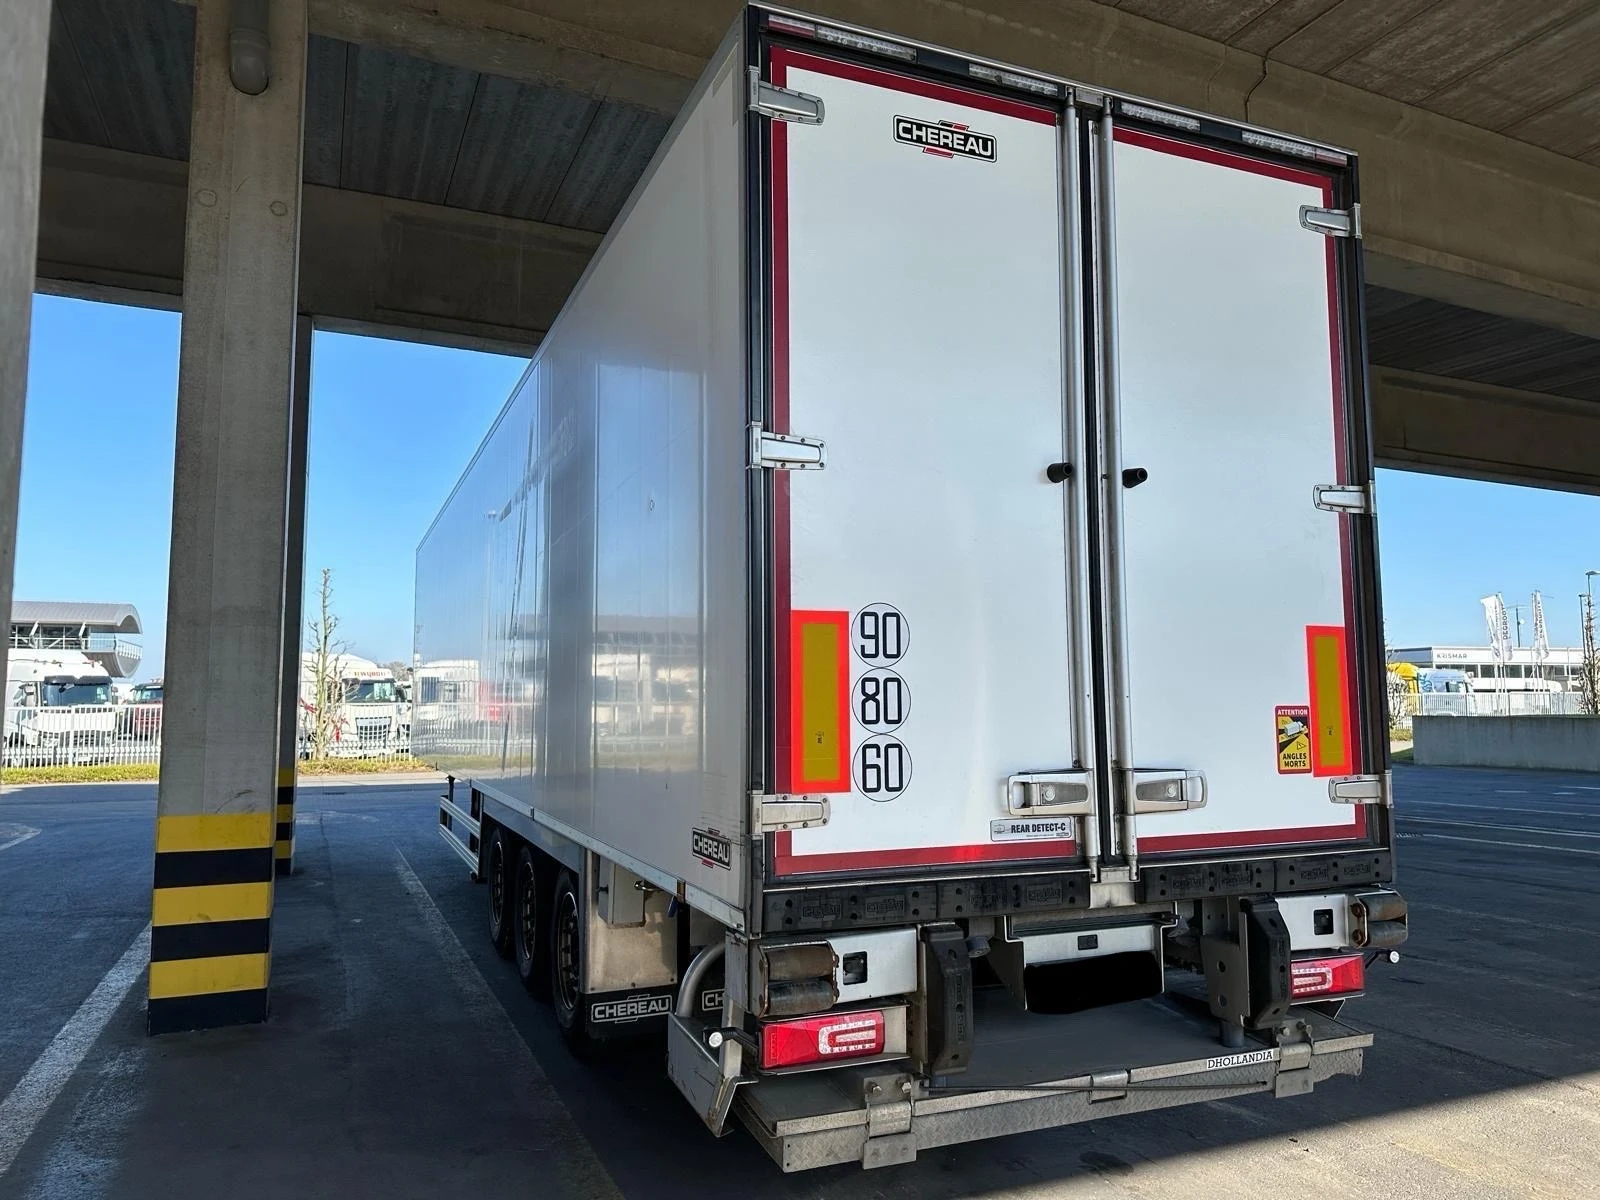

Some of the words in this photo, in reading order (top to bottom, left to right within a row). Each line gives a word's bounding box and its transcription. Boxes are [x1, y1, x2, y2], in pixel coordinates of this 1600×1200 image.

[898, 121, 992, 157] CHEREAU
[860, 611, 901, 659] 90
[861, 677, 902, 725] 80
[862, 743, 903, 793] 60
[1284, 760, 1306, 768] MORTS
[1010, 824, 1030, 834] REAR
[1031, 822, 1066, 833] DETECT-C
[693, 834, 730, 863] CHEREAU
[594, 999, 669, 1019] CHEREAU
[1207, 1050, 1273, 1069] DHOLLANDIA
